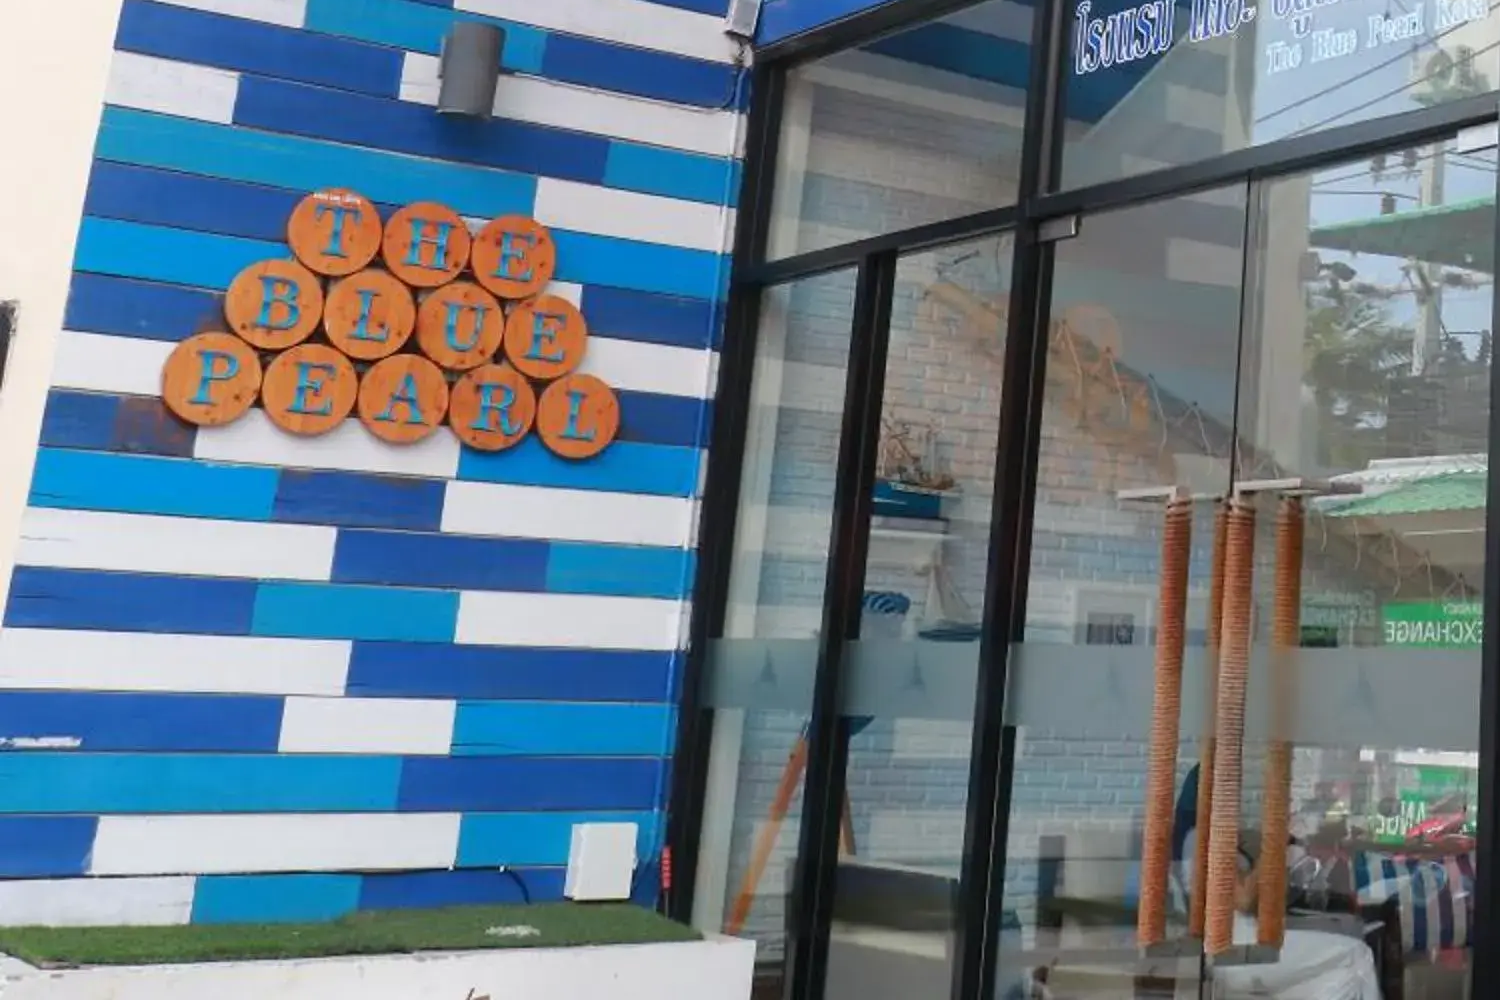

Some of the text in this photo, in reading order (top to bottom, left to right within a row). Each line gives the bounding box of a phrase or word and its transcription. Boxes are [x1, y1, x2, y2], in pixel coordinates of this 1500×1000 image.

[1266, 40, 1301, 76] The
[1310, 26, 1357, 64] Blue
[316, 203, 537, 283] THE
[250, 275, 567, 362] BLUE
[186, 350, 595, 441] PEARL
